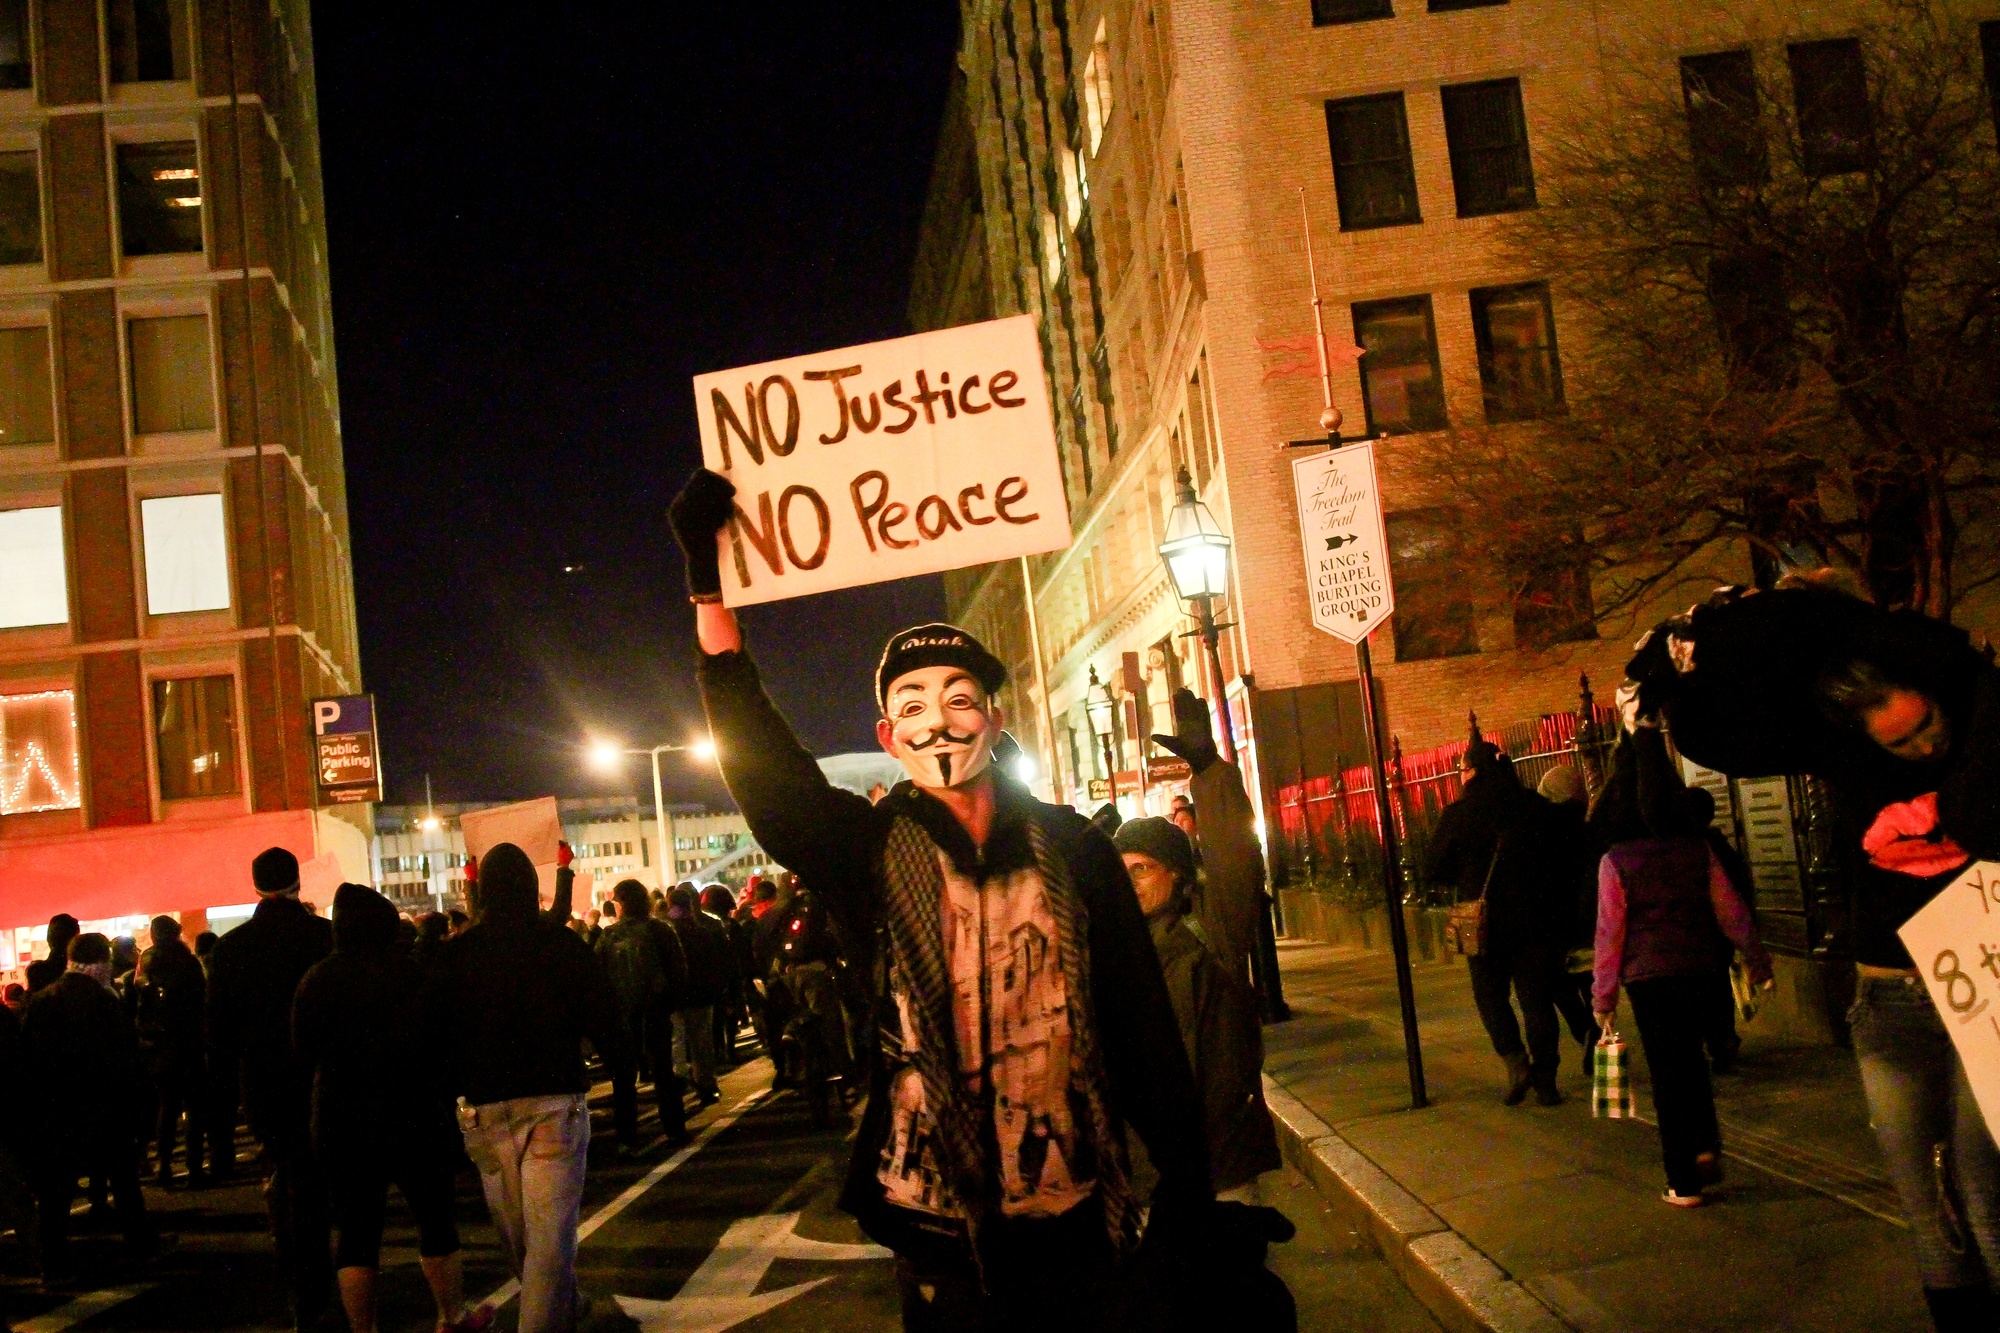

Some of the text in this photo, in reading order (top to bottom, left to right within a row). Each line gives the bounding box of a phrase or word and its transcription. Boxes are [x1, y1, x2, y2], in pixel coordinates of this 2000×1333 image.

[711, 364, 1026, 470] NO Justice
[1317, 469, 1347, 491] The
[1306, 485, 1366, 513] Freedom
[729, 470, 1040, 588] NO Peace
[1320, 505, 1356, 530] Trail
[1320, 551, 1370, 572] KING'S
[1318, 566, 1375, 587] CHAPEL
[1317, 580, 1381, 603] BURYING
[1321, 595, 1381, 617] GROUND
[314, 701, 341, 735] P
[321, 743, 360, 756] Public
[322, 756, 371, 769] Parking
[1933, 949, 1977, 1013] 8
